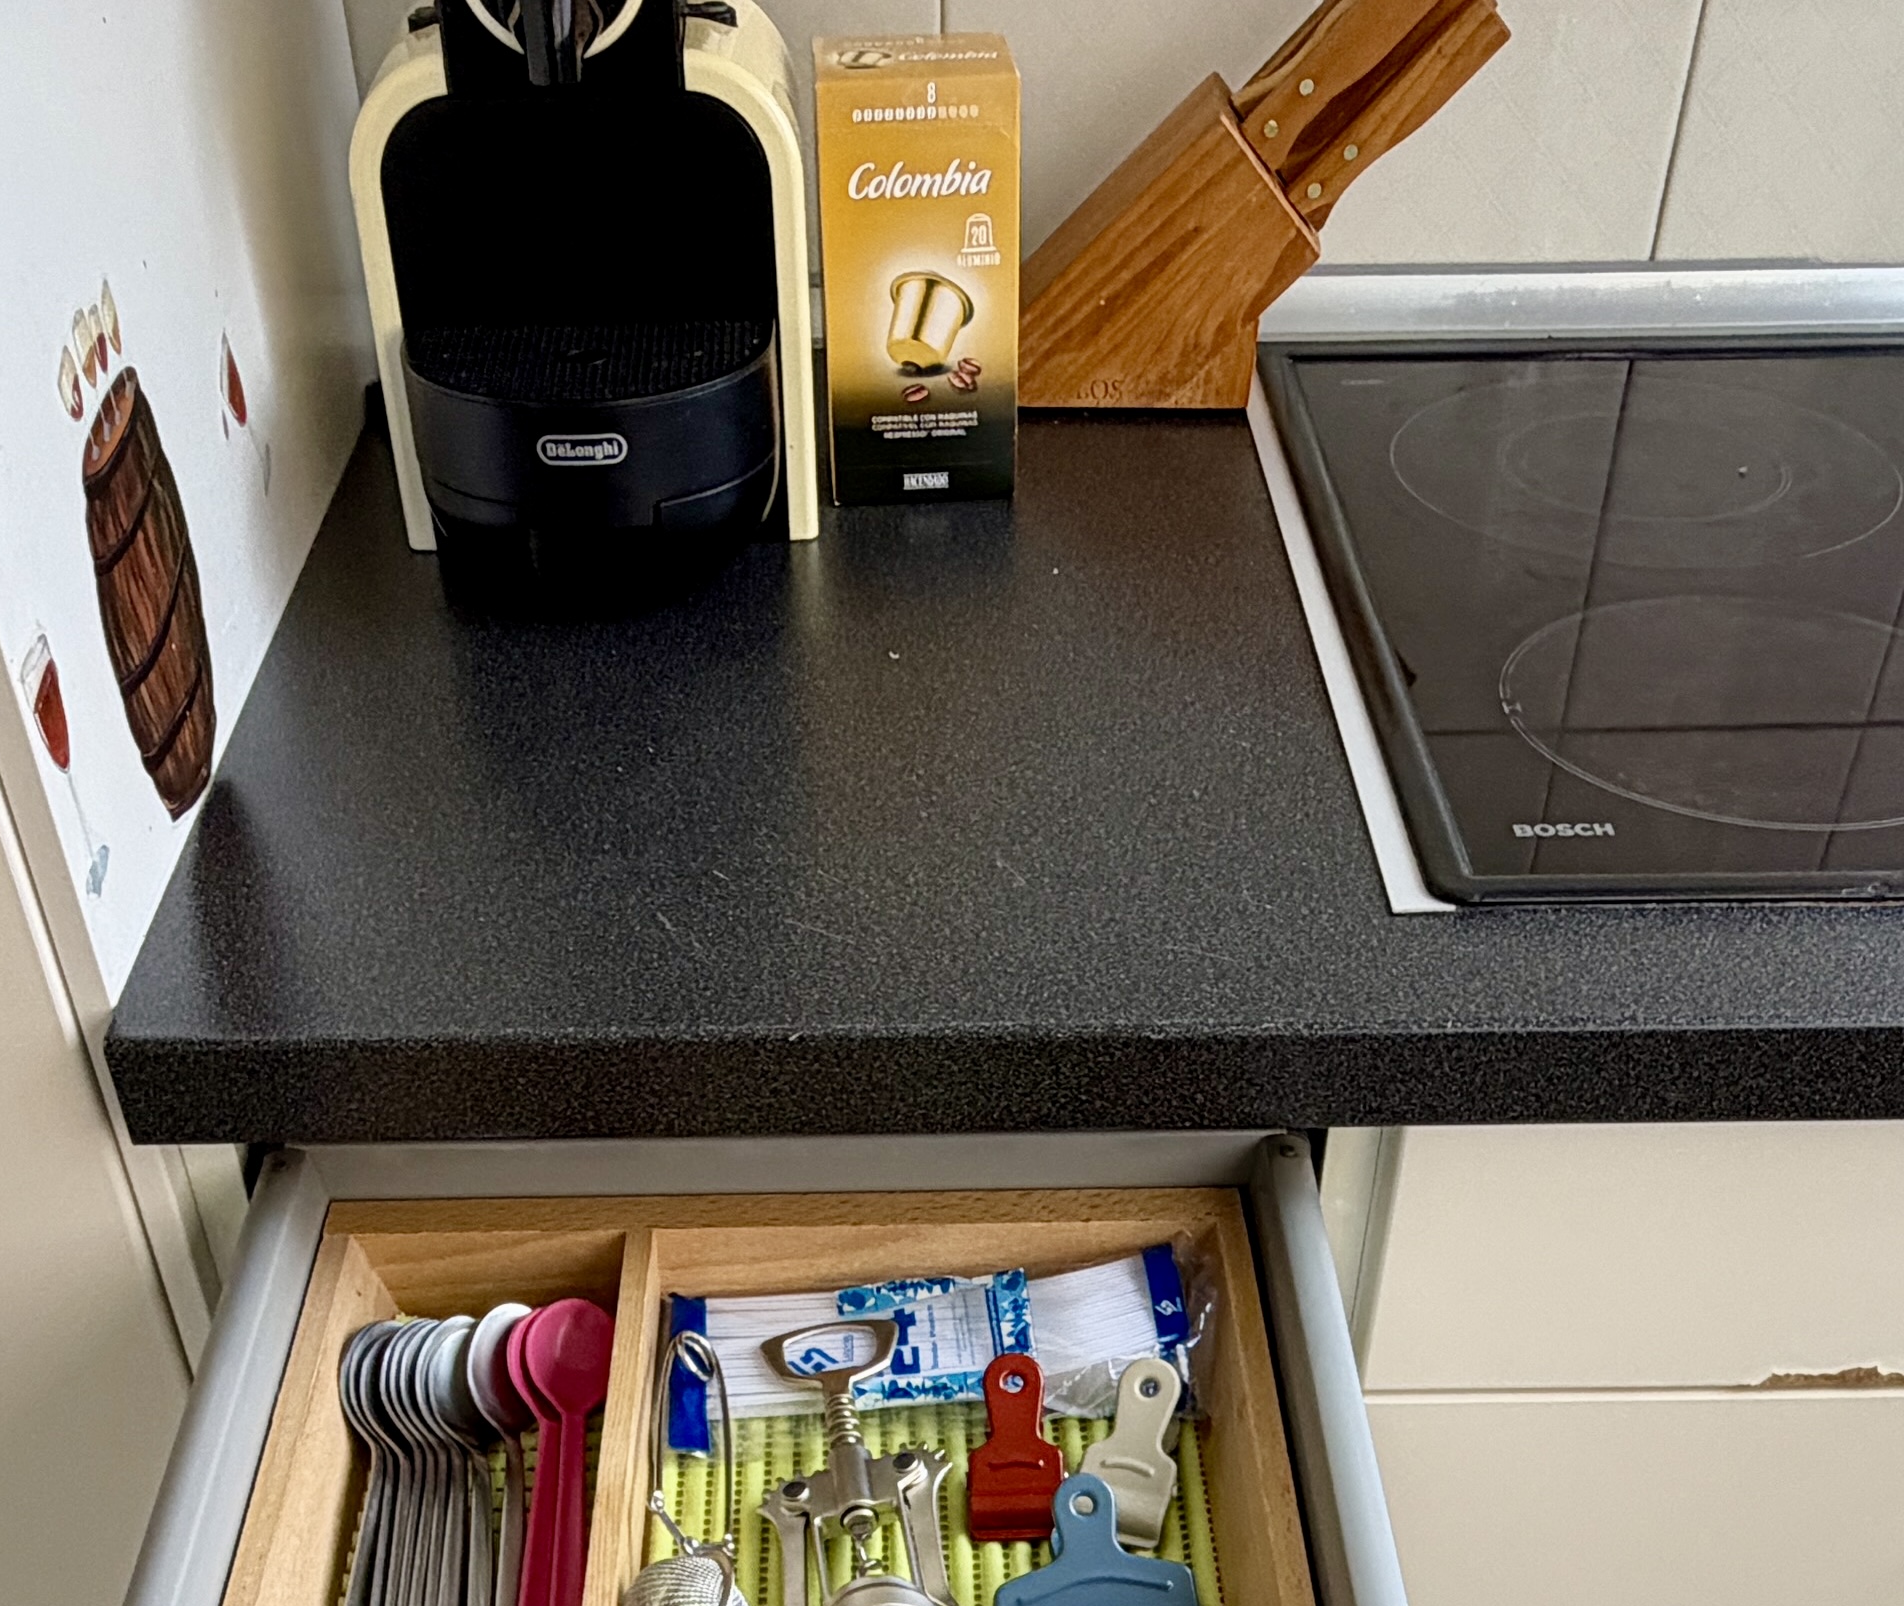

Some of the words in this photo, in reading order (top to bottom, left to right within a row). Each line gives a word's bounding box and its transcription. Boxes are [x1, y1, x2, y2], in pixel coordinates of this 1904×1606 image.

[927, 81, 936, 104] 8
[847, 158, 992, 200] Colombia
[970, 225, 987, 246] 20
[1512, 822, 1616, 838] BOSCH
